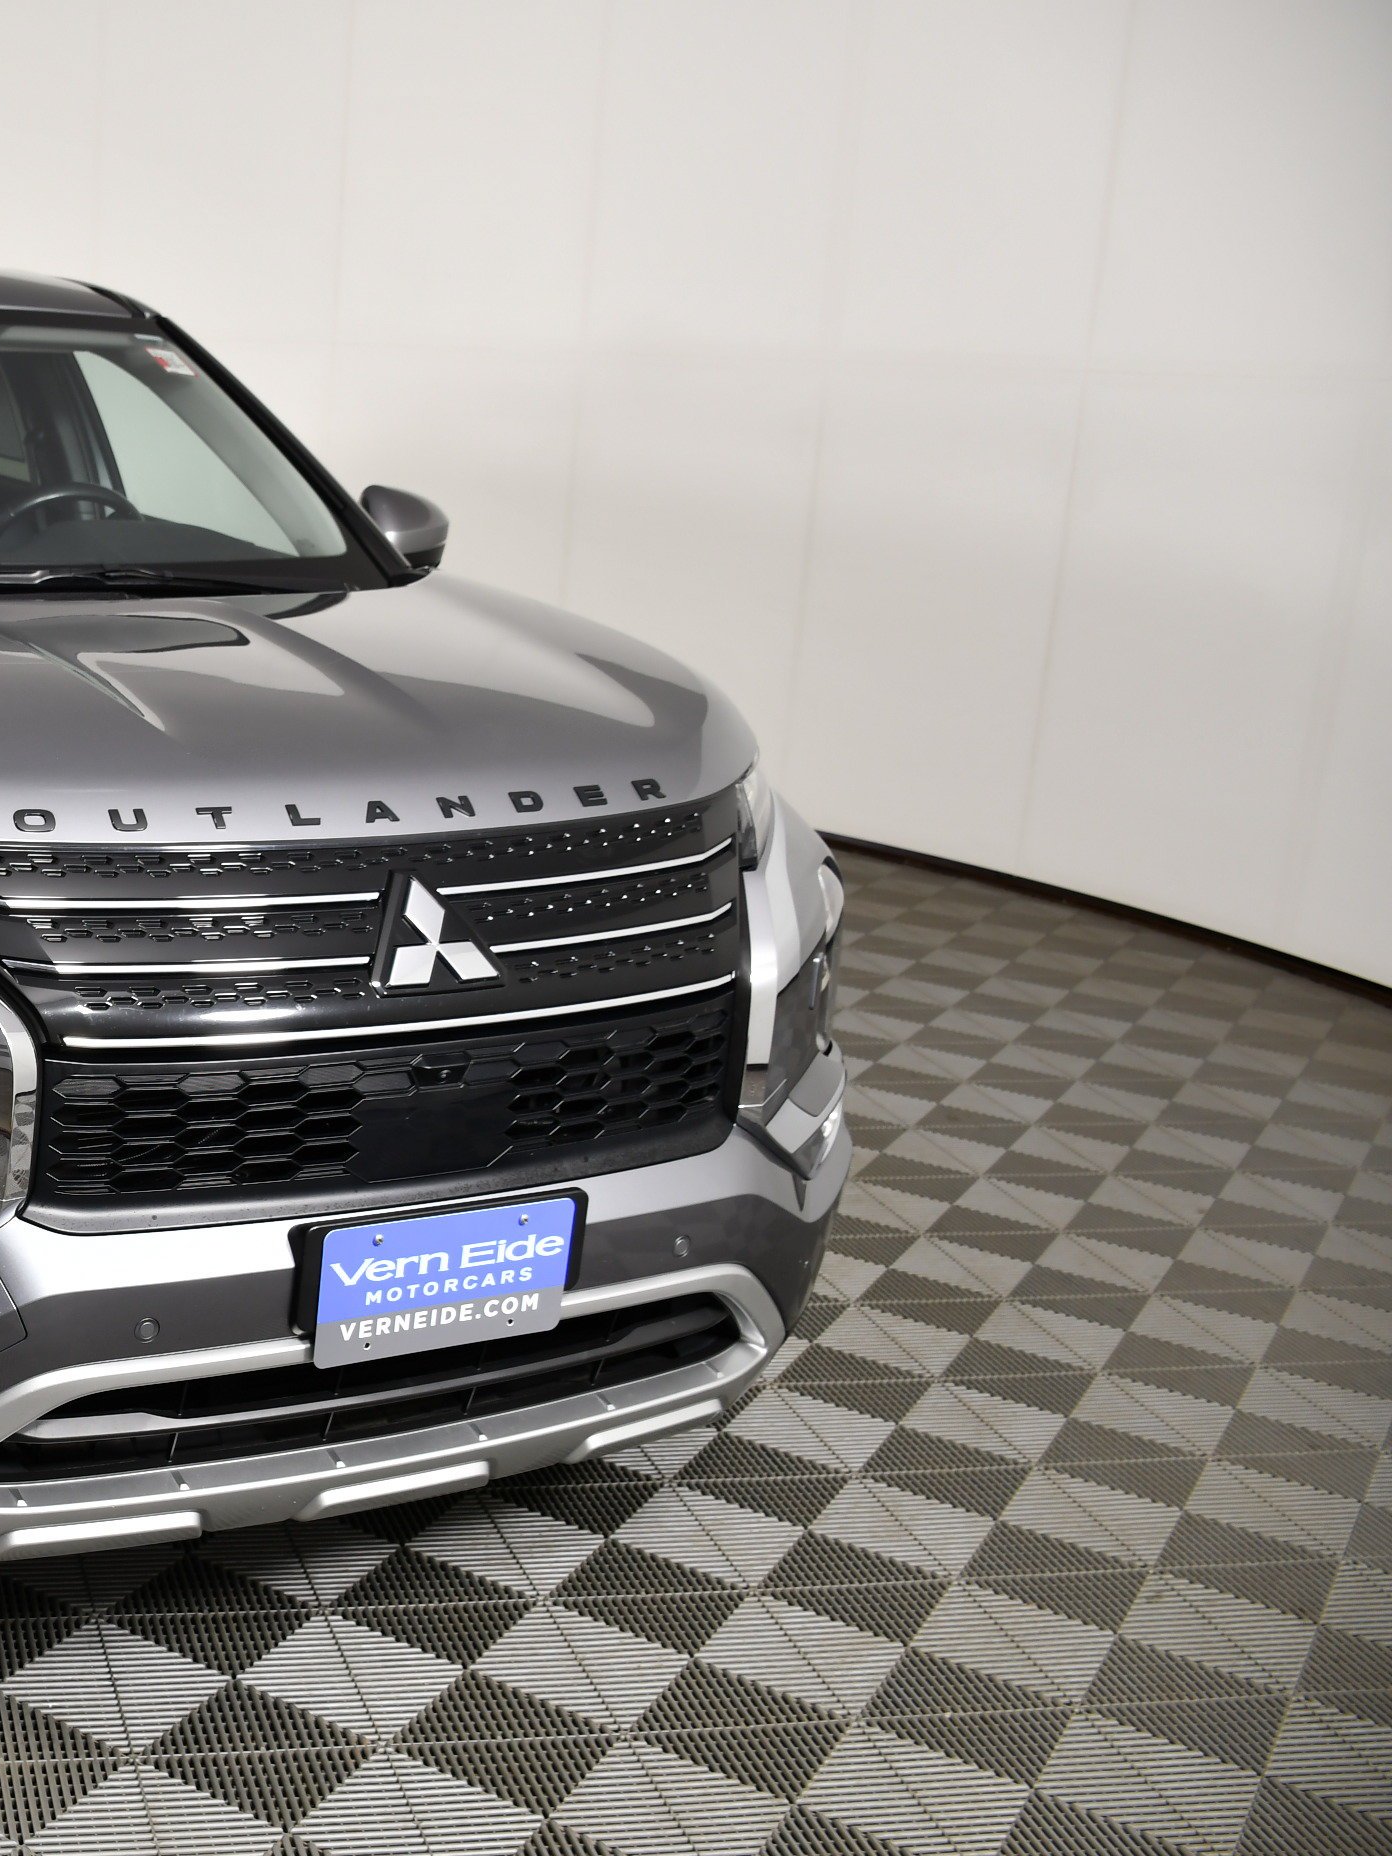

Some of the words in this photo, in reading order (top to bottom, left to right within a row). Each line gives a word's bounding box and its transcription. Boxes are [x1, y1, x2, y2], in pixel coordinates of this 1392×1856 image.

[12, 777, 667, 832] OUTLANDER
[330, 1251, 450, 1286] Vern
[459, 1234, 565, 1269] Eide
[365, 1267, 534, 1306] MOTORCARS
[340, 1293, 540, 1341] VERNEIDE.COM
